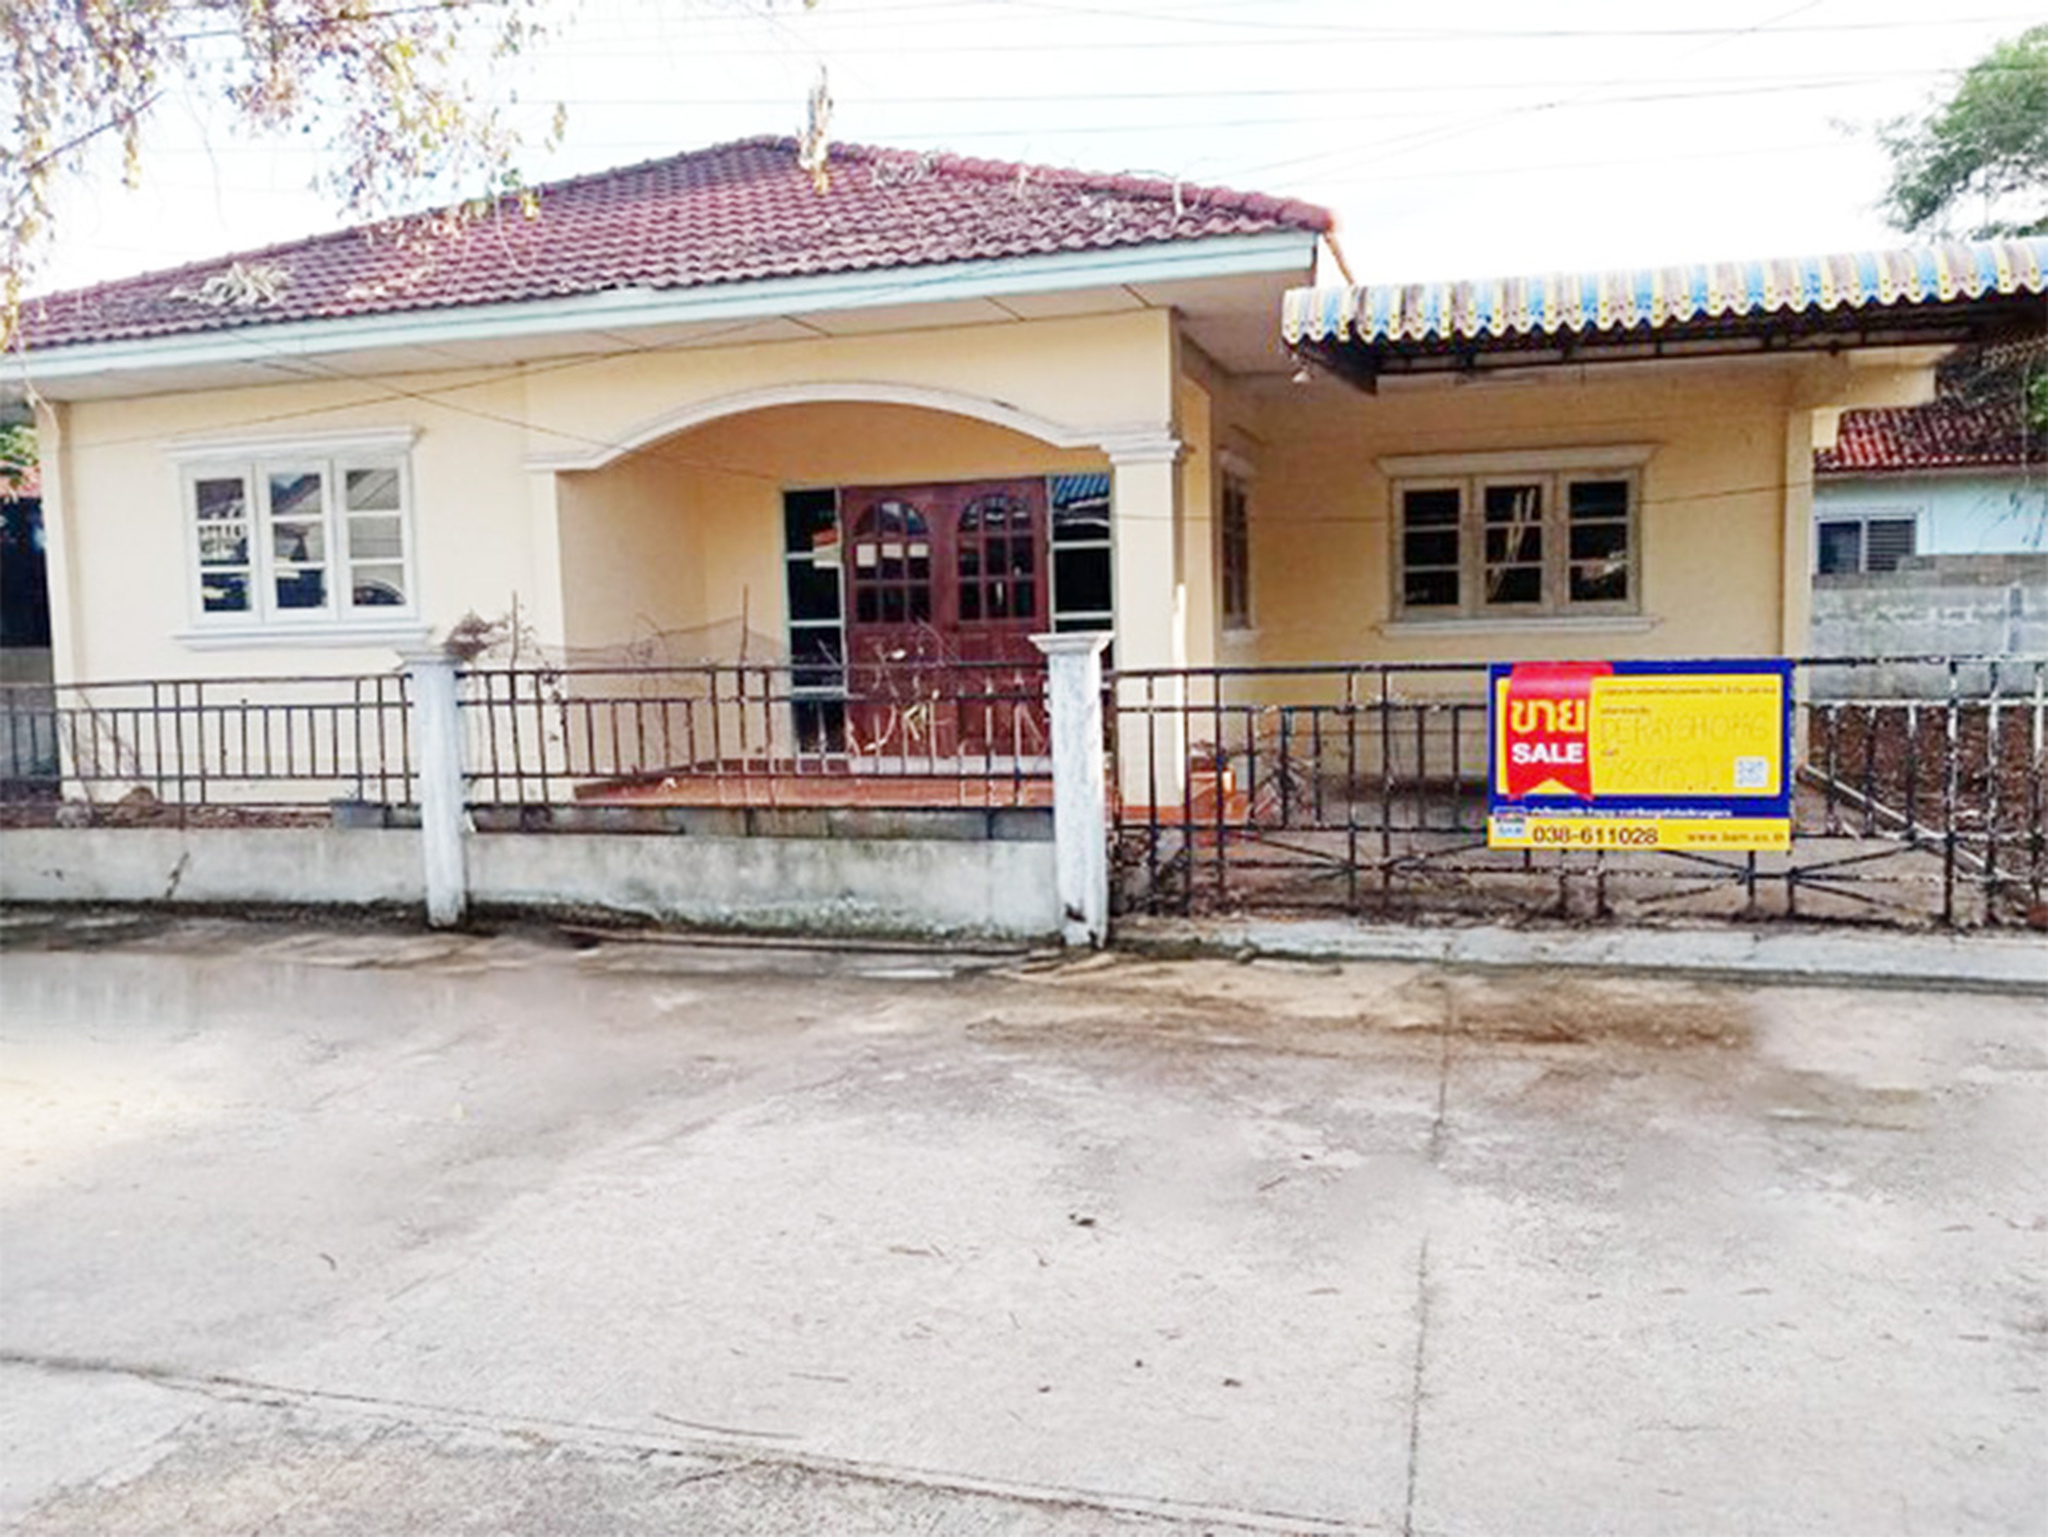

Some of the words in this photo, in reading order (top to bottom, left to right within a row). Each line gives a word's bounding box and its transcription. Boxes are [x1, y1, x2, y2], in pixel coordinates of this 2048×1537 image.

[1511, 699, 1585, 732] ขาย
[1511, 742, 1584, 763] SALE
[1532, 826, 1658, 844] 038-611028
